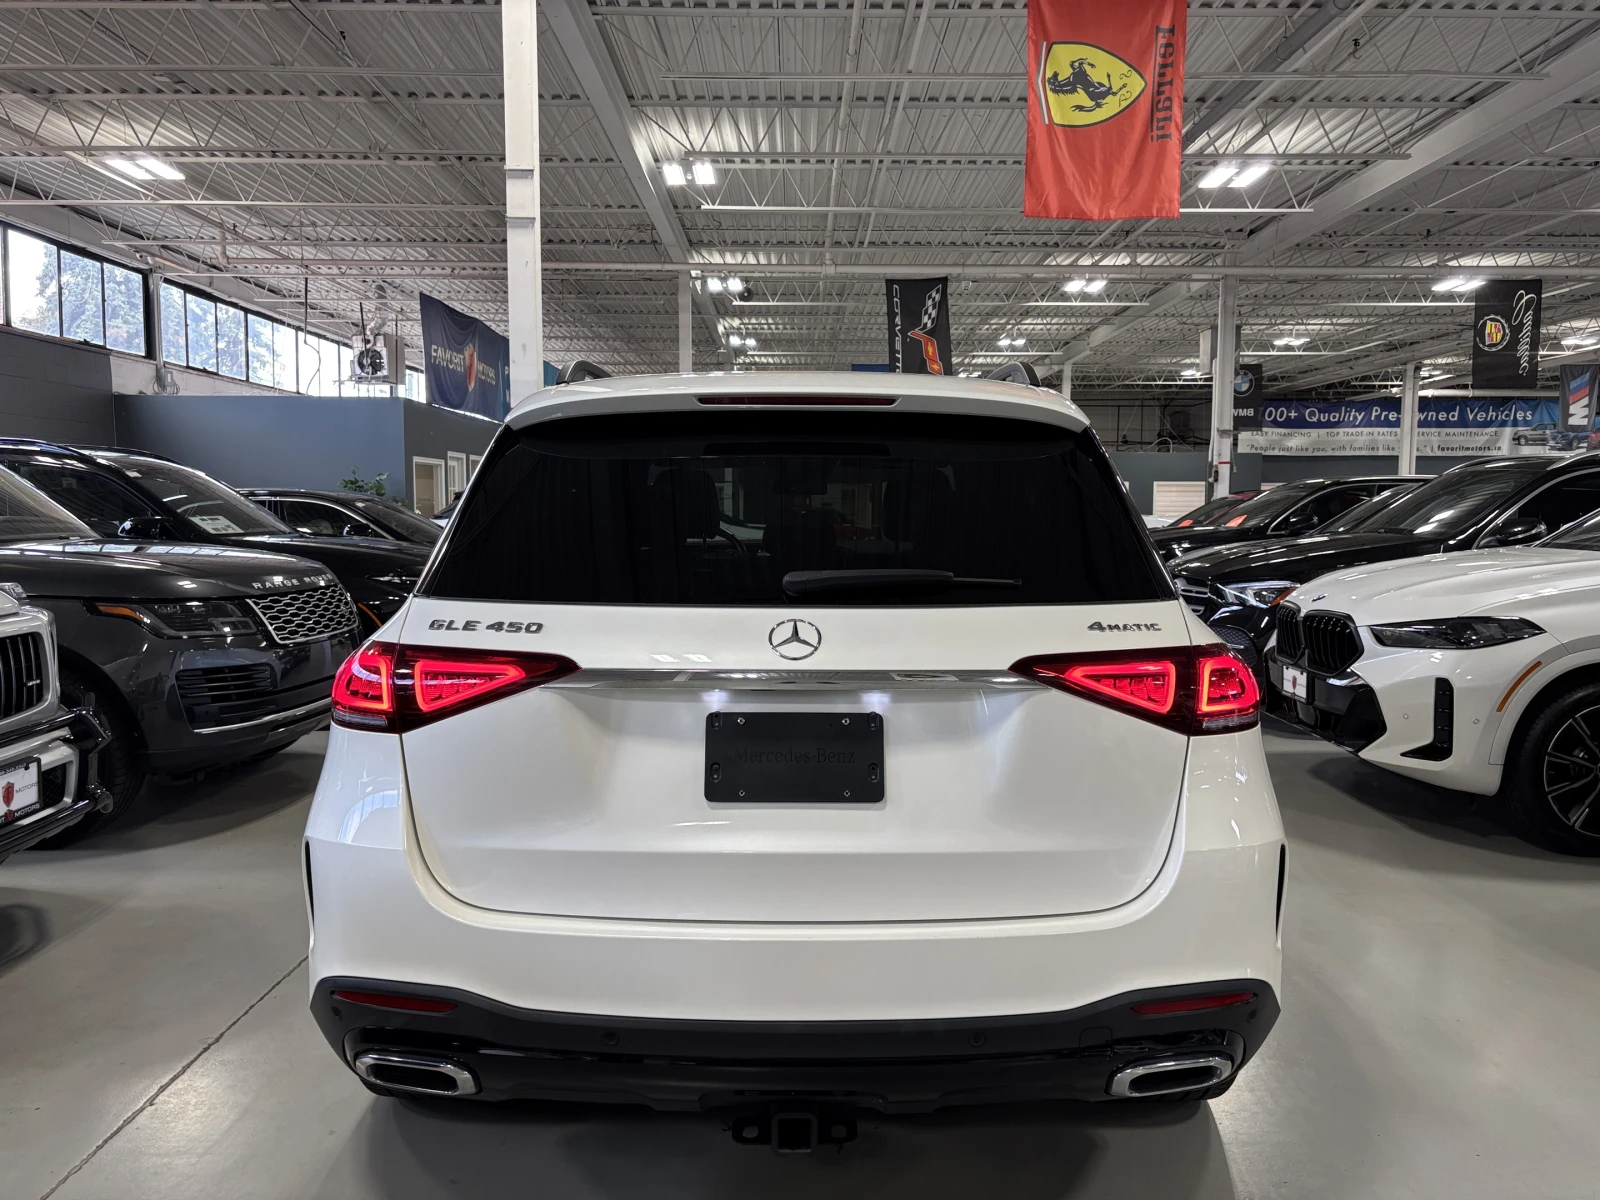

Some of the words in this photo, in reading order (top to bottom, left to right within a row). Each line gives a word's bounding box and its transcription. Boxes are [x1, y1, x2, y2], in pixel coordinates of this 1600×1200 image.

[893, 284, 902, 373] CORVETT
[431, 344, 465, 373] FAVORIT
[477, 360, 496, 385] MOTORS
[1264, 406, 1299, 422] 00+
[1305, 406, 1365, 426] Quality
[1371, 405, 1459, 422] Pre-wned
[1467, 405, 1533, 422] Vehicles
[1278, 443, 1293, 453] just
[1295, 443, 1309, 452] like
[1312, 445, 1328, 453] you,
[1331, 443, 1347, 452] with
[1349, 443, 1380, 452] families
[1382, 443, 1396, 452] like
[1437, 444, 1502, 452] favoritmotors.ca
[252, 578, 300, 590] RANGE
[303, 573, 333, 585] ROVER
[428, 619, 482, 632] GLE
[485, 621, 544, 634] 450
[1086, 620, 1162, 633] 4MATIC
[732, 747, 856, 765] Mercedes-Benz
[15, 781, 39, 794] MOTORS
[14, 803, 41, 818] MOTORS
